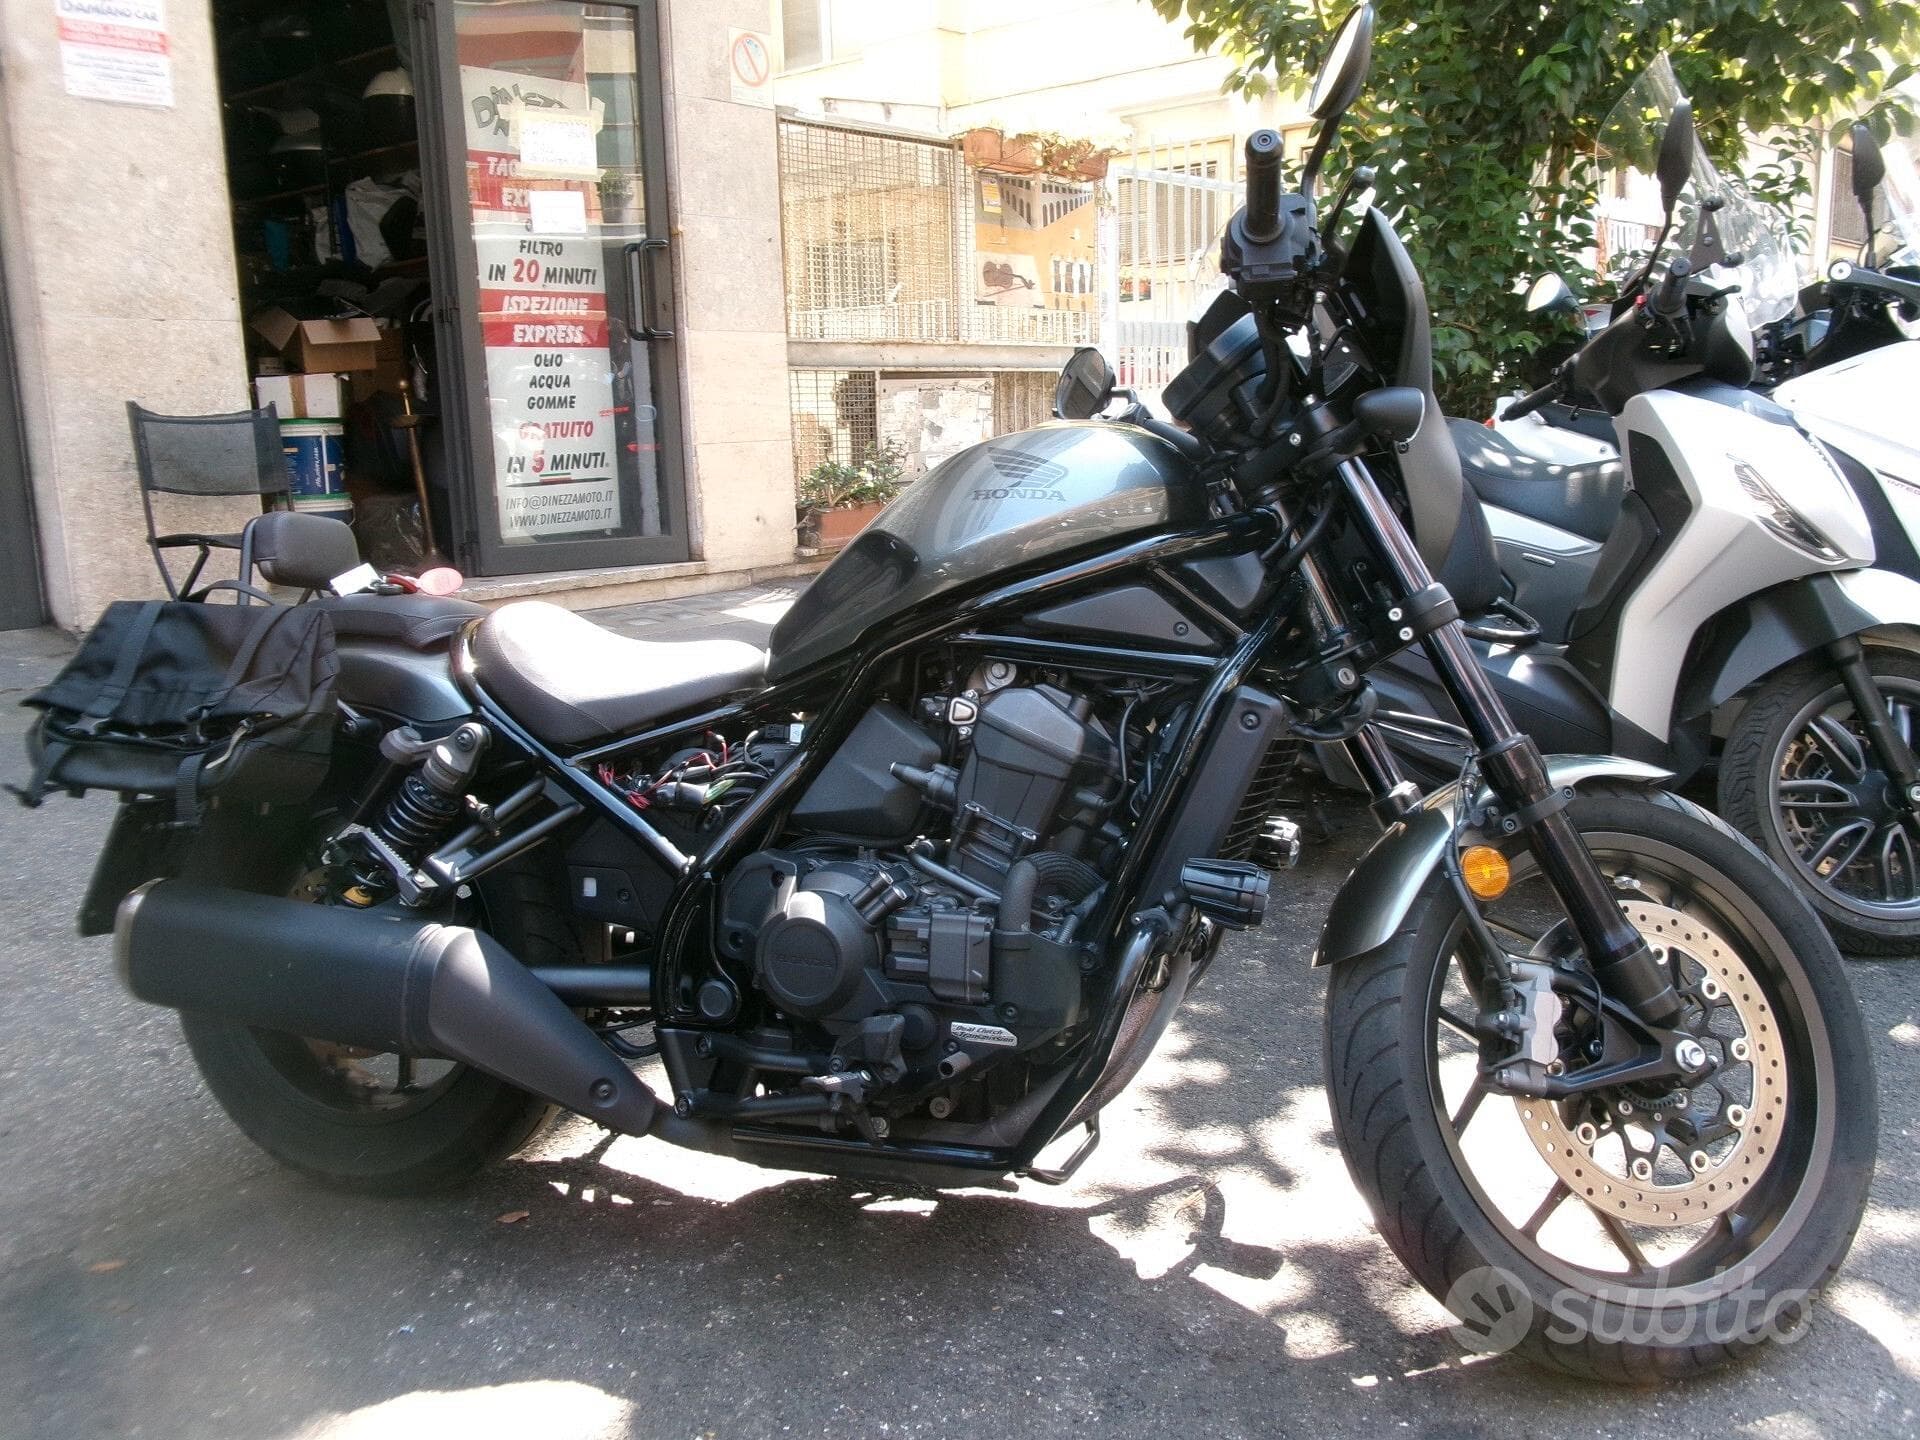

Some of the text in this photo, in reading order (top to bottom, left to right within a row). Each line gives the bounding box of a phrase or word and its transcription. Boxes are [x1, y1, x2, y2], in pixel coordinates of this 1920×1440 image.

[519, 239, 564, 257] FILTRO
[488, 258, 598, 286] IN 20 MINUTI
[502, 295, 589, 318] ISPEZIONE
[512, 324, 586, 344] EXPRESS
[533, 353, 564, 368] OLIO
[529, 374, 571, 389] ACQUA
[527, 395, 577, 410] GOMME
[506, 456, 526, 474] IN
[531, 449, 545, 473] 5
[505, 490, 614, 510] INFO@DINEZZAMOTO.IT
[972, 488, 1066, 502] HONDA
[510, 507, 613, 528] WWW.DINEZZAMOTO.IT
